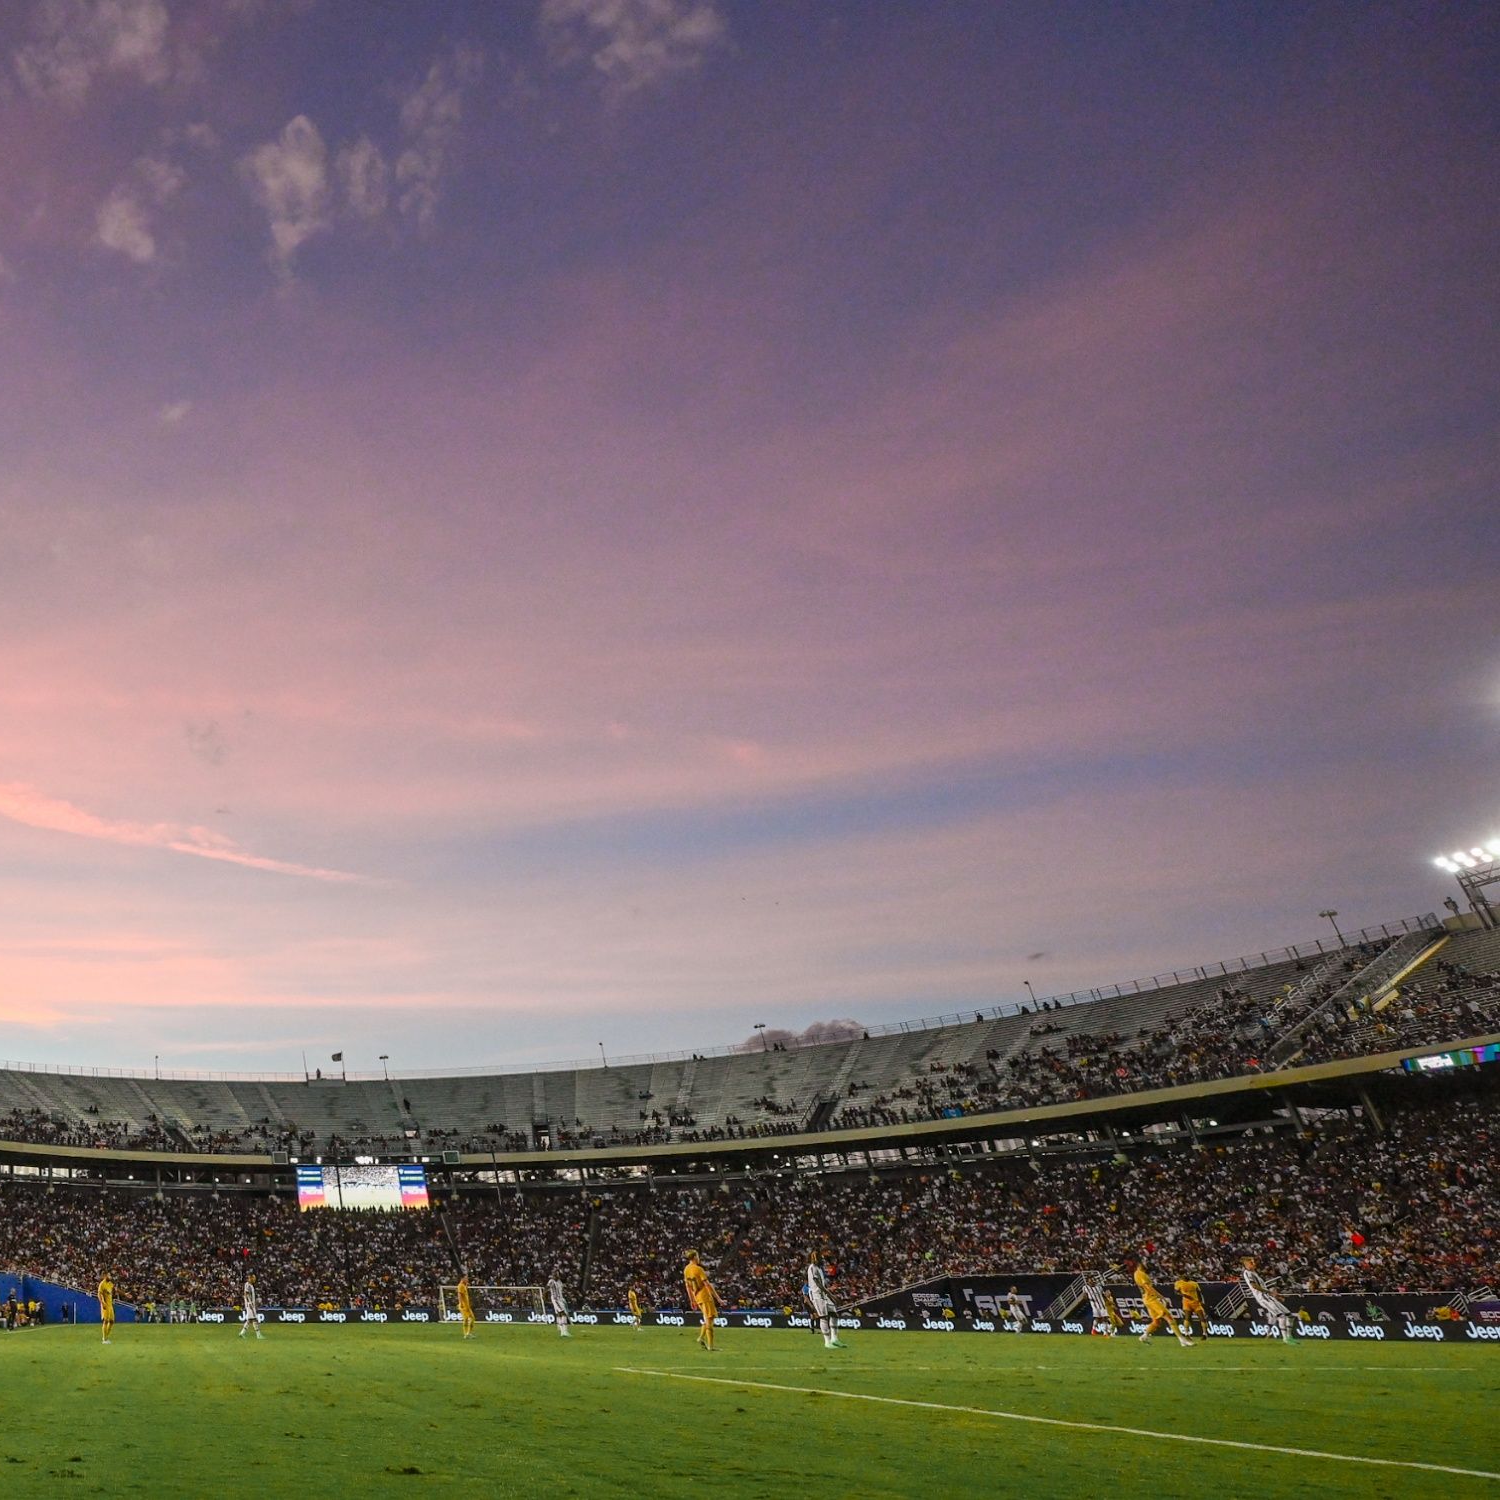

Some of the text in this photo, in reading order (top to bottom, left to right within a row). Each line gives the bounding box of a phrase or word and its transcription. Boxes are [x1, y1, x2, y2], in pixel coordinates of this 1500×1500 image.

[1116, 1298, 1173, 1308] SOCR
[199, 1311, 224, 1323] Jeep
[239, 1311, 265, 1323] Jp
[279, 1311, 305, 1323] Jeep
[320, 1311, 346, 1323] Jeep
[361, 1311, 388, 1323] Jeep
[402, 1311, 429, 1323] Jeep
[443, 1310, 462, 1321] Jee
[485, 1311, 513, 1323] Jeep
[527, 1312, 555, 1324] Jeep
[570, 1312, 598, 1325] Jeep
[613, 1313, 636, 1324] Jee
[656, 1313, 685, 1326] Jeep
[743, 1314, 772, 1328] Jeep
[837, 1318, 861, 1329] eep
[876, 1316, 906, 1330] Jeep
[922, 1318, 955, 1331] Jeep
[972, 1319, 995, 1332] Jeep
[1003, 1319, 1019, 1331] Jee
[1031, 1319, 1051, 1333] Jeep
[1061, 1319, 1083, 1334] Jeep
[1129, 1320, 1149, 1333] Jee
[1207, 1321, 1234, 1337] Jeep
[1296, 1321, 1331, 1339] Jeep
[1348, 1321, 1385, 1340] Jeep
[1404, 1321, 1444, 1341] Jeep
